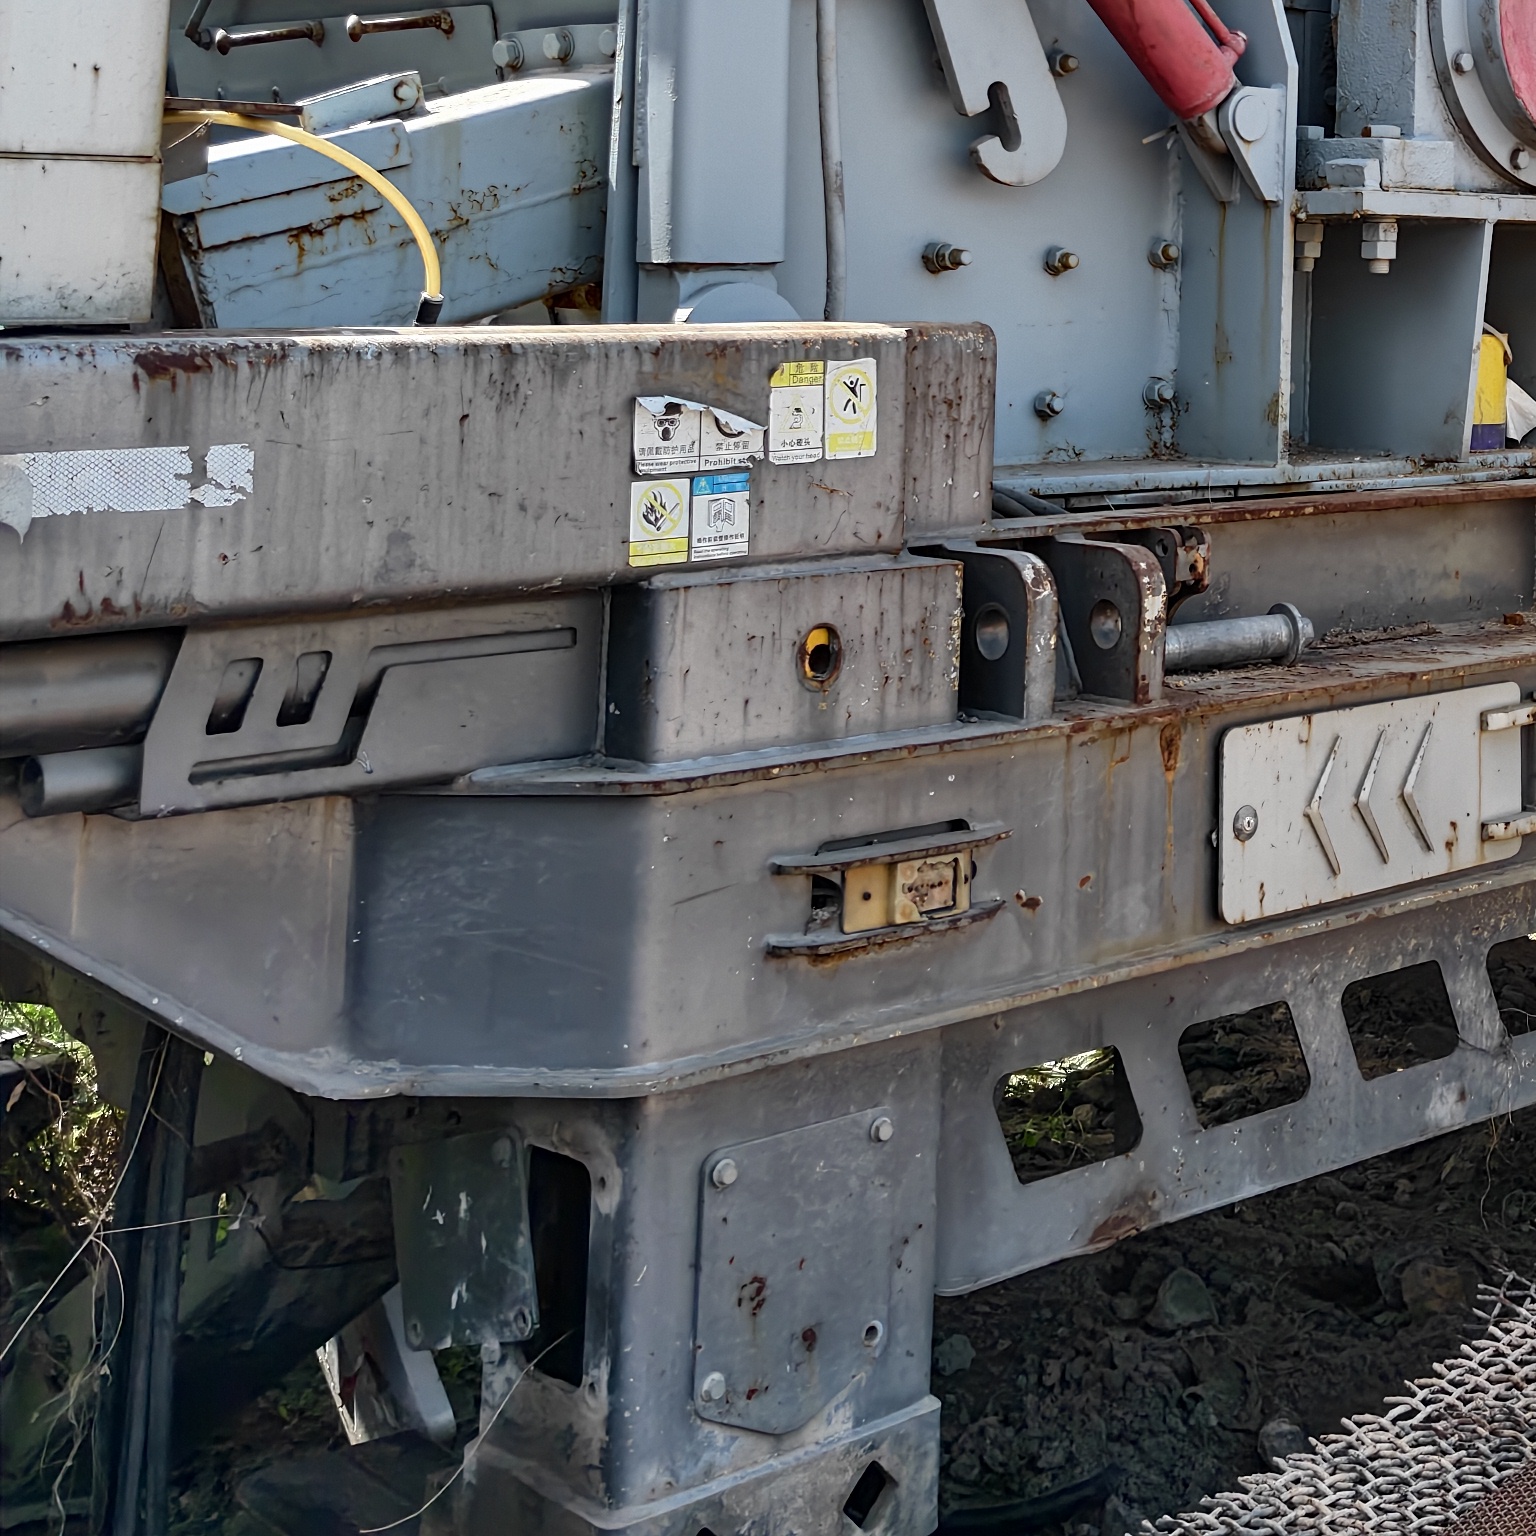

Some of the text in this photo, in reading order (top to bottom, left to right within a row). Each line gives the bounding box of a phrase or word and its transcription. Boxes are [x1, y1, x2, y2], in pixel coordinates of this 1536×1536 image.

[792, 375, 823, 385] Danger
[715, 440, 750, 452] 禁止停留
[704, 457, 737, 467] Prohibit
